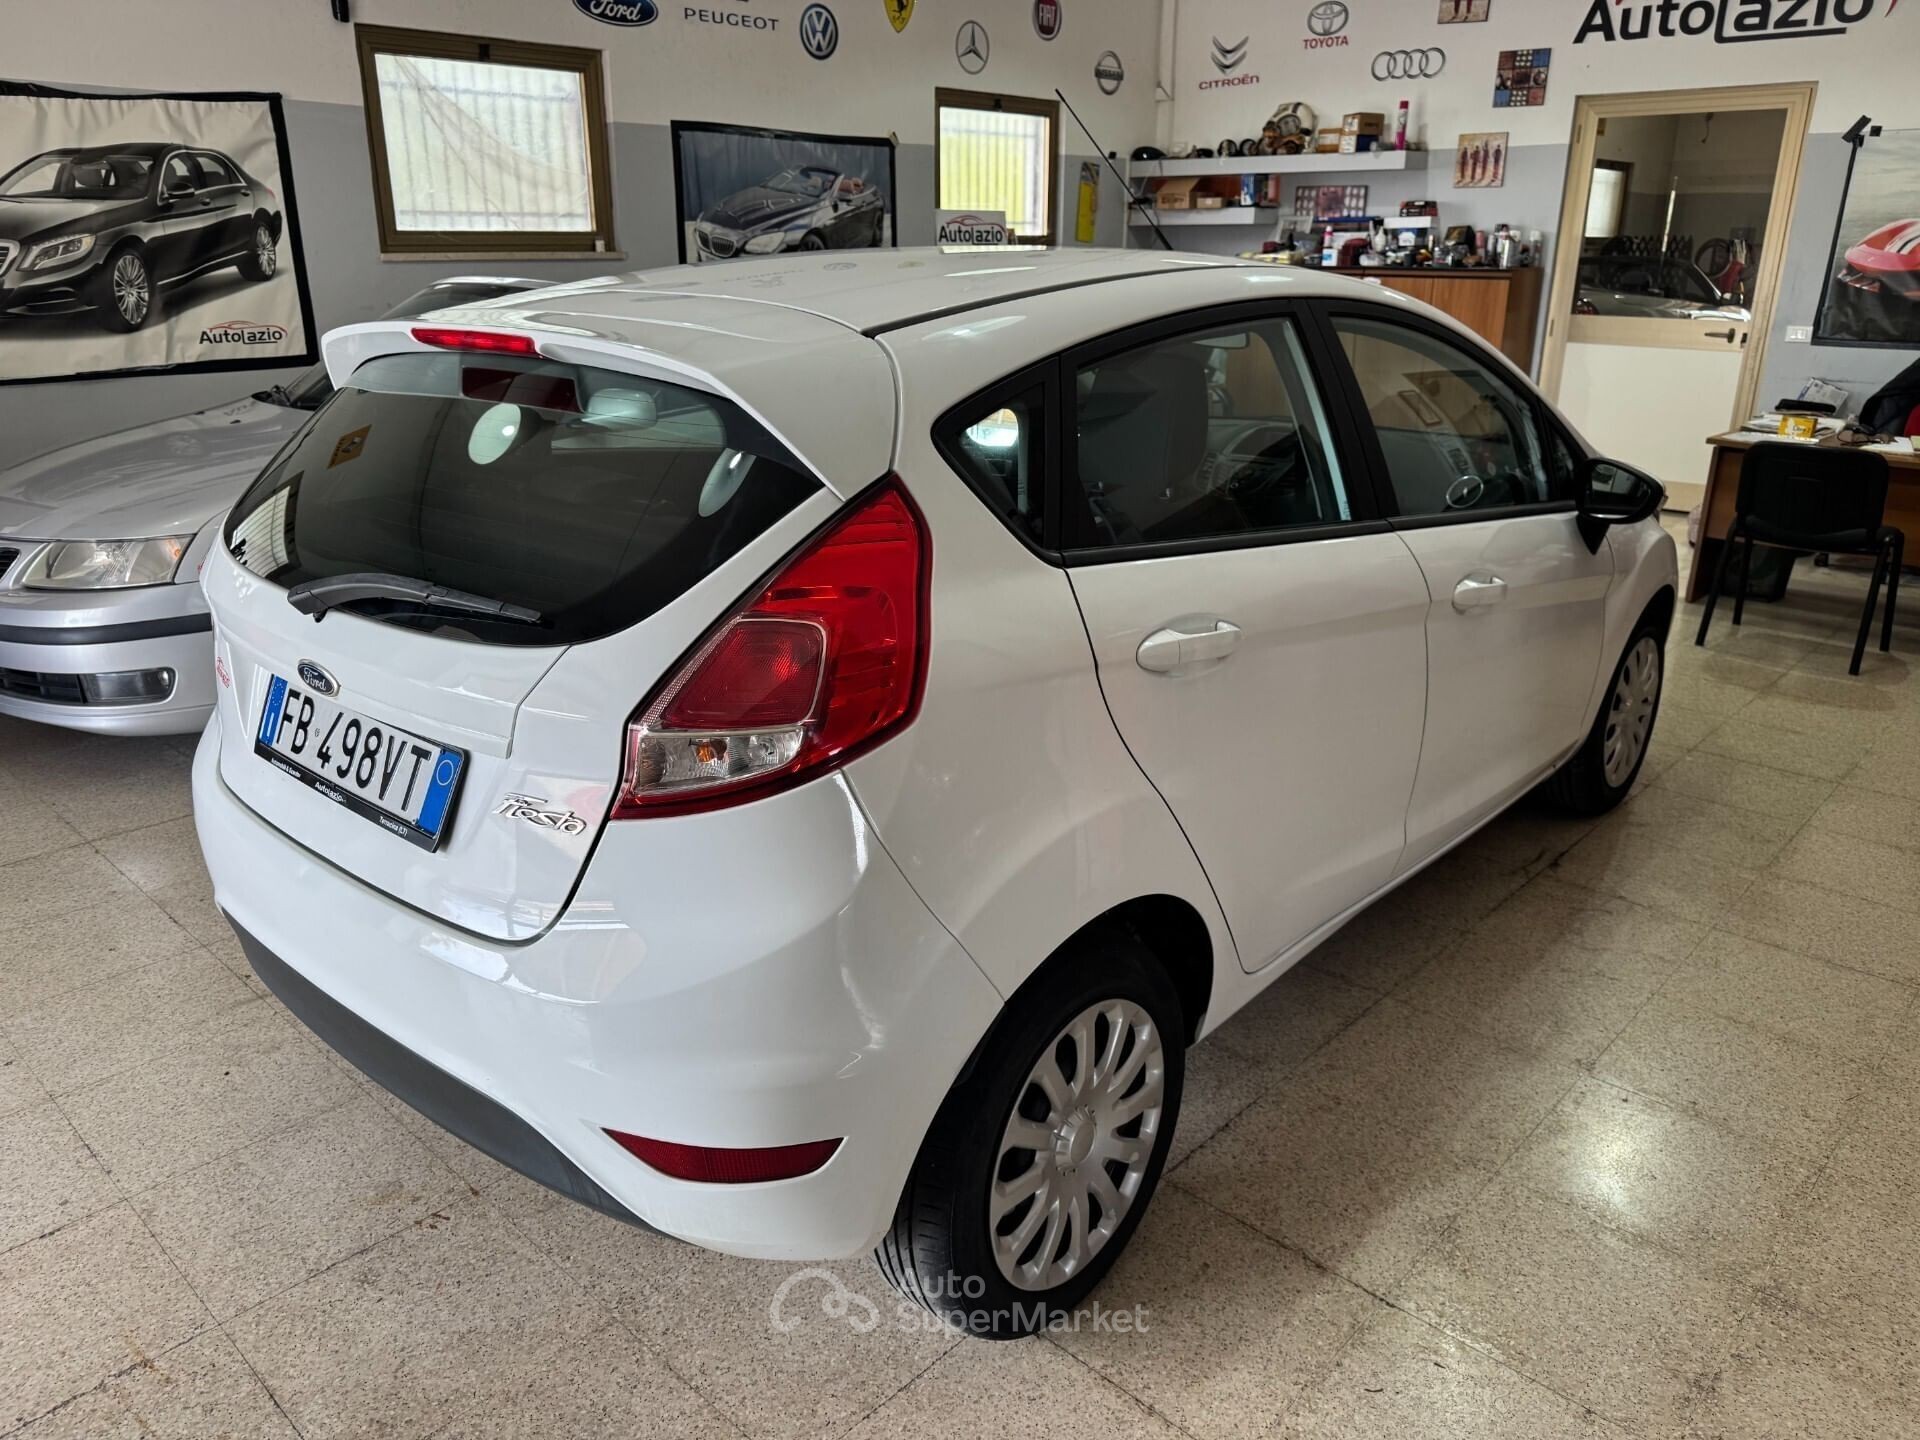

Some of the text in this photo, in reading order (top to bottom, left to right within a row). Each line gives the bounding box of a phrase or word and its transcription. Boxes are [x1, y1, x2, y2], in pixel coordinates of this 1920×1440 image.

[590, 0, 641, 21] Ford
[683, 7, 779, 31] PEUGEOT
[1039, 4, 1056, 27] FIAT
[1303, 35, 1349, 49] TOYOTA
[303, 667, 326, 691] Ford
[276, 688, 433, 812] FB 498VT
[492, 792, 587, 835] Fiesta
